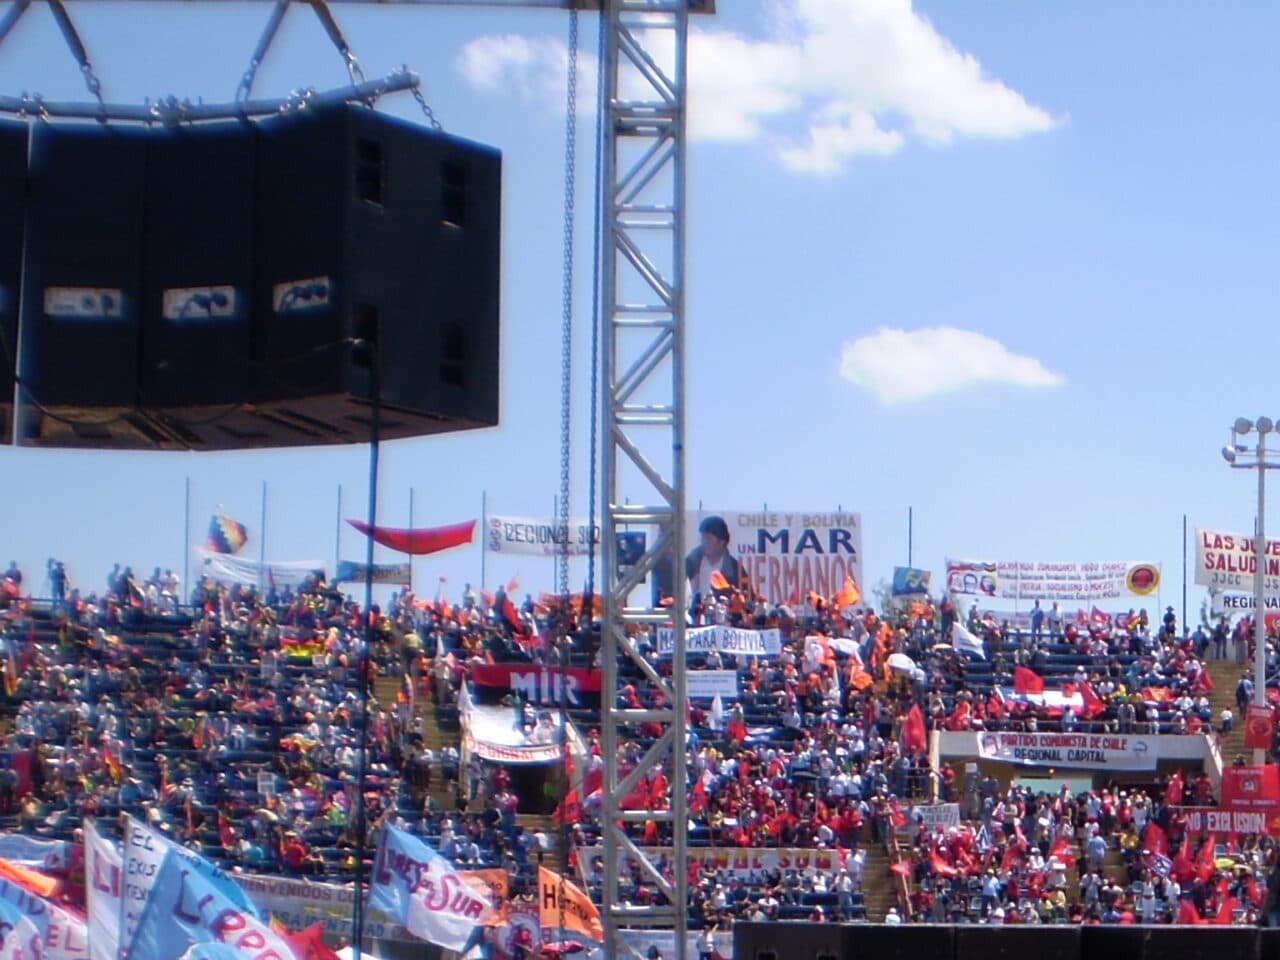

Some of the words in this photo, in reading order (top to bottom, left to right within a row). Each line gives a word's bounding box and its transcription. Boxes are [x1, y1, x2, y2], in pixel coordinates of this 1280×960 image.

[738, 514, 777, 527] CHILE
[785, 514, 793, 527] Y
[803, 514, 857, 527] BOLIVIA
[737, 544, 755, 553] UN
[757, 529, 857, 554] MAR
[1203, 532, 1235, 550] LAS
[737, 555, 858, 603] HERMANOS
[722, 630, 766, 650] BOLIVIA
[510, 671, 579, 705] MIR
[1001, 734, 1038, 747] PARTIDO
[1040, 735, 1087, 748] COMUNISTA
[1090, 736, 1101, 748] DE
[1103, 737, 1128, 750] CHILE
[1014, 748, 1063, 761] REGIONAL
[1067, 749, 1107, 763] CAPITAL
[1186, 812, 1201, 831] NO
[1207, 811, 1266, 833] EXCLUSION
[242, 879, 331, 899] IENVENIDOS
